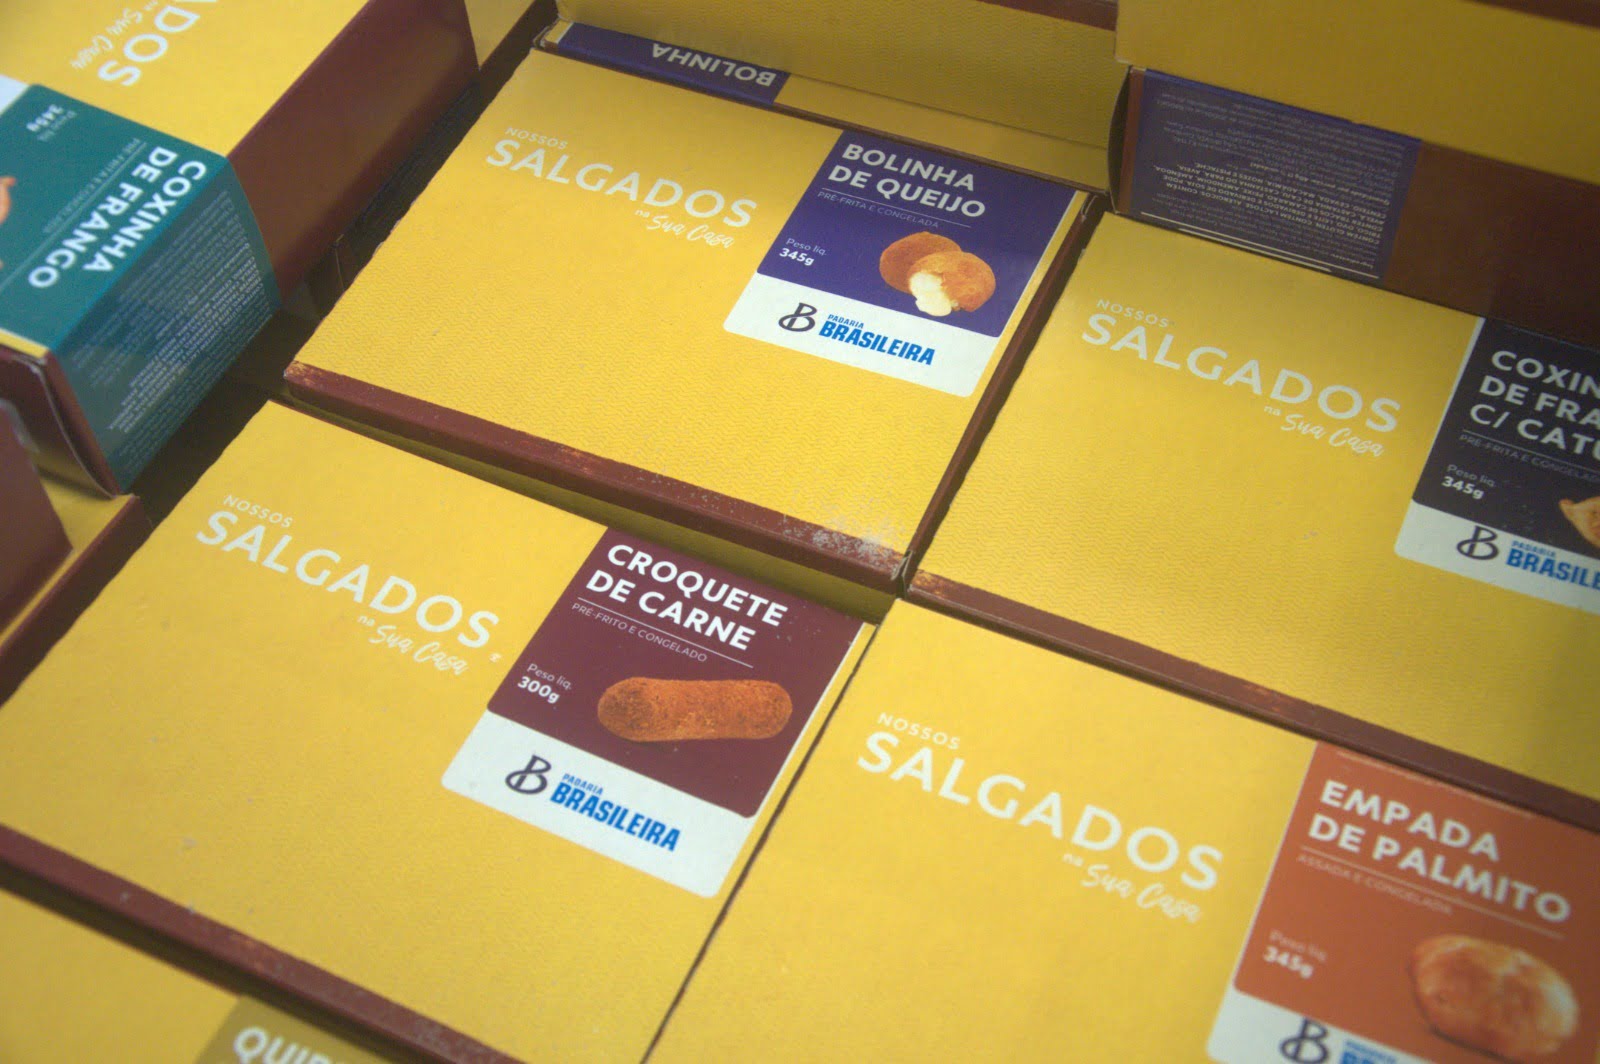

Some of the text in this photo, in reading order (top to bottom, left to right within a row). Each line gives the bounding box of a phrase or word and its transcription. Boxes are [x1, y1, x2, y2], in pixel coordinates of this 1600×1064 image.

[98, 0, 218, 87] DOS
[652, 43, 777, 87] BOLINHA
[505, 127, 569, 150] NOSSOS
[131, 146, 178, 183] DE
[486, 139, 757, 228] SALGADOS
[842, 144, 976, 192] BOLINHA
[828, 165, 986, 218] DE QUEIJO
[28, 182, 143, 288] FRANGO
[83, 161, 207, 272] COXINHA
[635, 209, 735, 249] na Sua Casa
[877, 206, 939, 229] CONGELADA
[779, 248, 815, 266] 345g
[786, 237, 812, 252] Peso
[828, 313, 864, 330] PADARIA
[1097, 299, 1168, 328] NOSSOS
[819, 320, 937, 366] BRASILEIRA
[1082, 314, 1400, 432] SALGADOS
[1491, 350, 1600, 399] COXIN
[1470, 404, 1511, 429] C/
[1479, 375, 1600, 431] DE FRA
[1264, 405, 1384, 457] na Sua Casa
[1441, 475, 1485, 500] 345g
[1447, 463, 1477, 481] Peso
[223, 495, 293, 528] NOSSOS
[196, 510, 499, 648] SALGADOS
[607, 544, 788, 627] CROQUETE
[572, 602, 707, 663] PRÉ-FRITO E CONGELADO
[586, 569, 756, 651] DE CARNE
[357, 614, 469, 676] na Sua Casa
[517, 676, 560, 704] 300g
[527, 663, 555, 682] Peso
[877, 712, 960, 750] NOSSOS
[562, 773, 603, 796] PADARIA
[550, 781, 681, 852] BRASILEIRA
[857, 731, 1224, 891] SALGADOS
[1320, 780, 1500, 862] EMPADA
[1308, 814, 1571, 922] DE PALMITO
[1081, 864, 1134, 899] Sua
[1135, 883, 1202, 924] Casa
[1263, 945, 1314, 979] 345g
